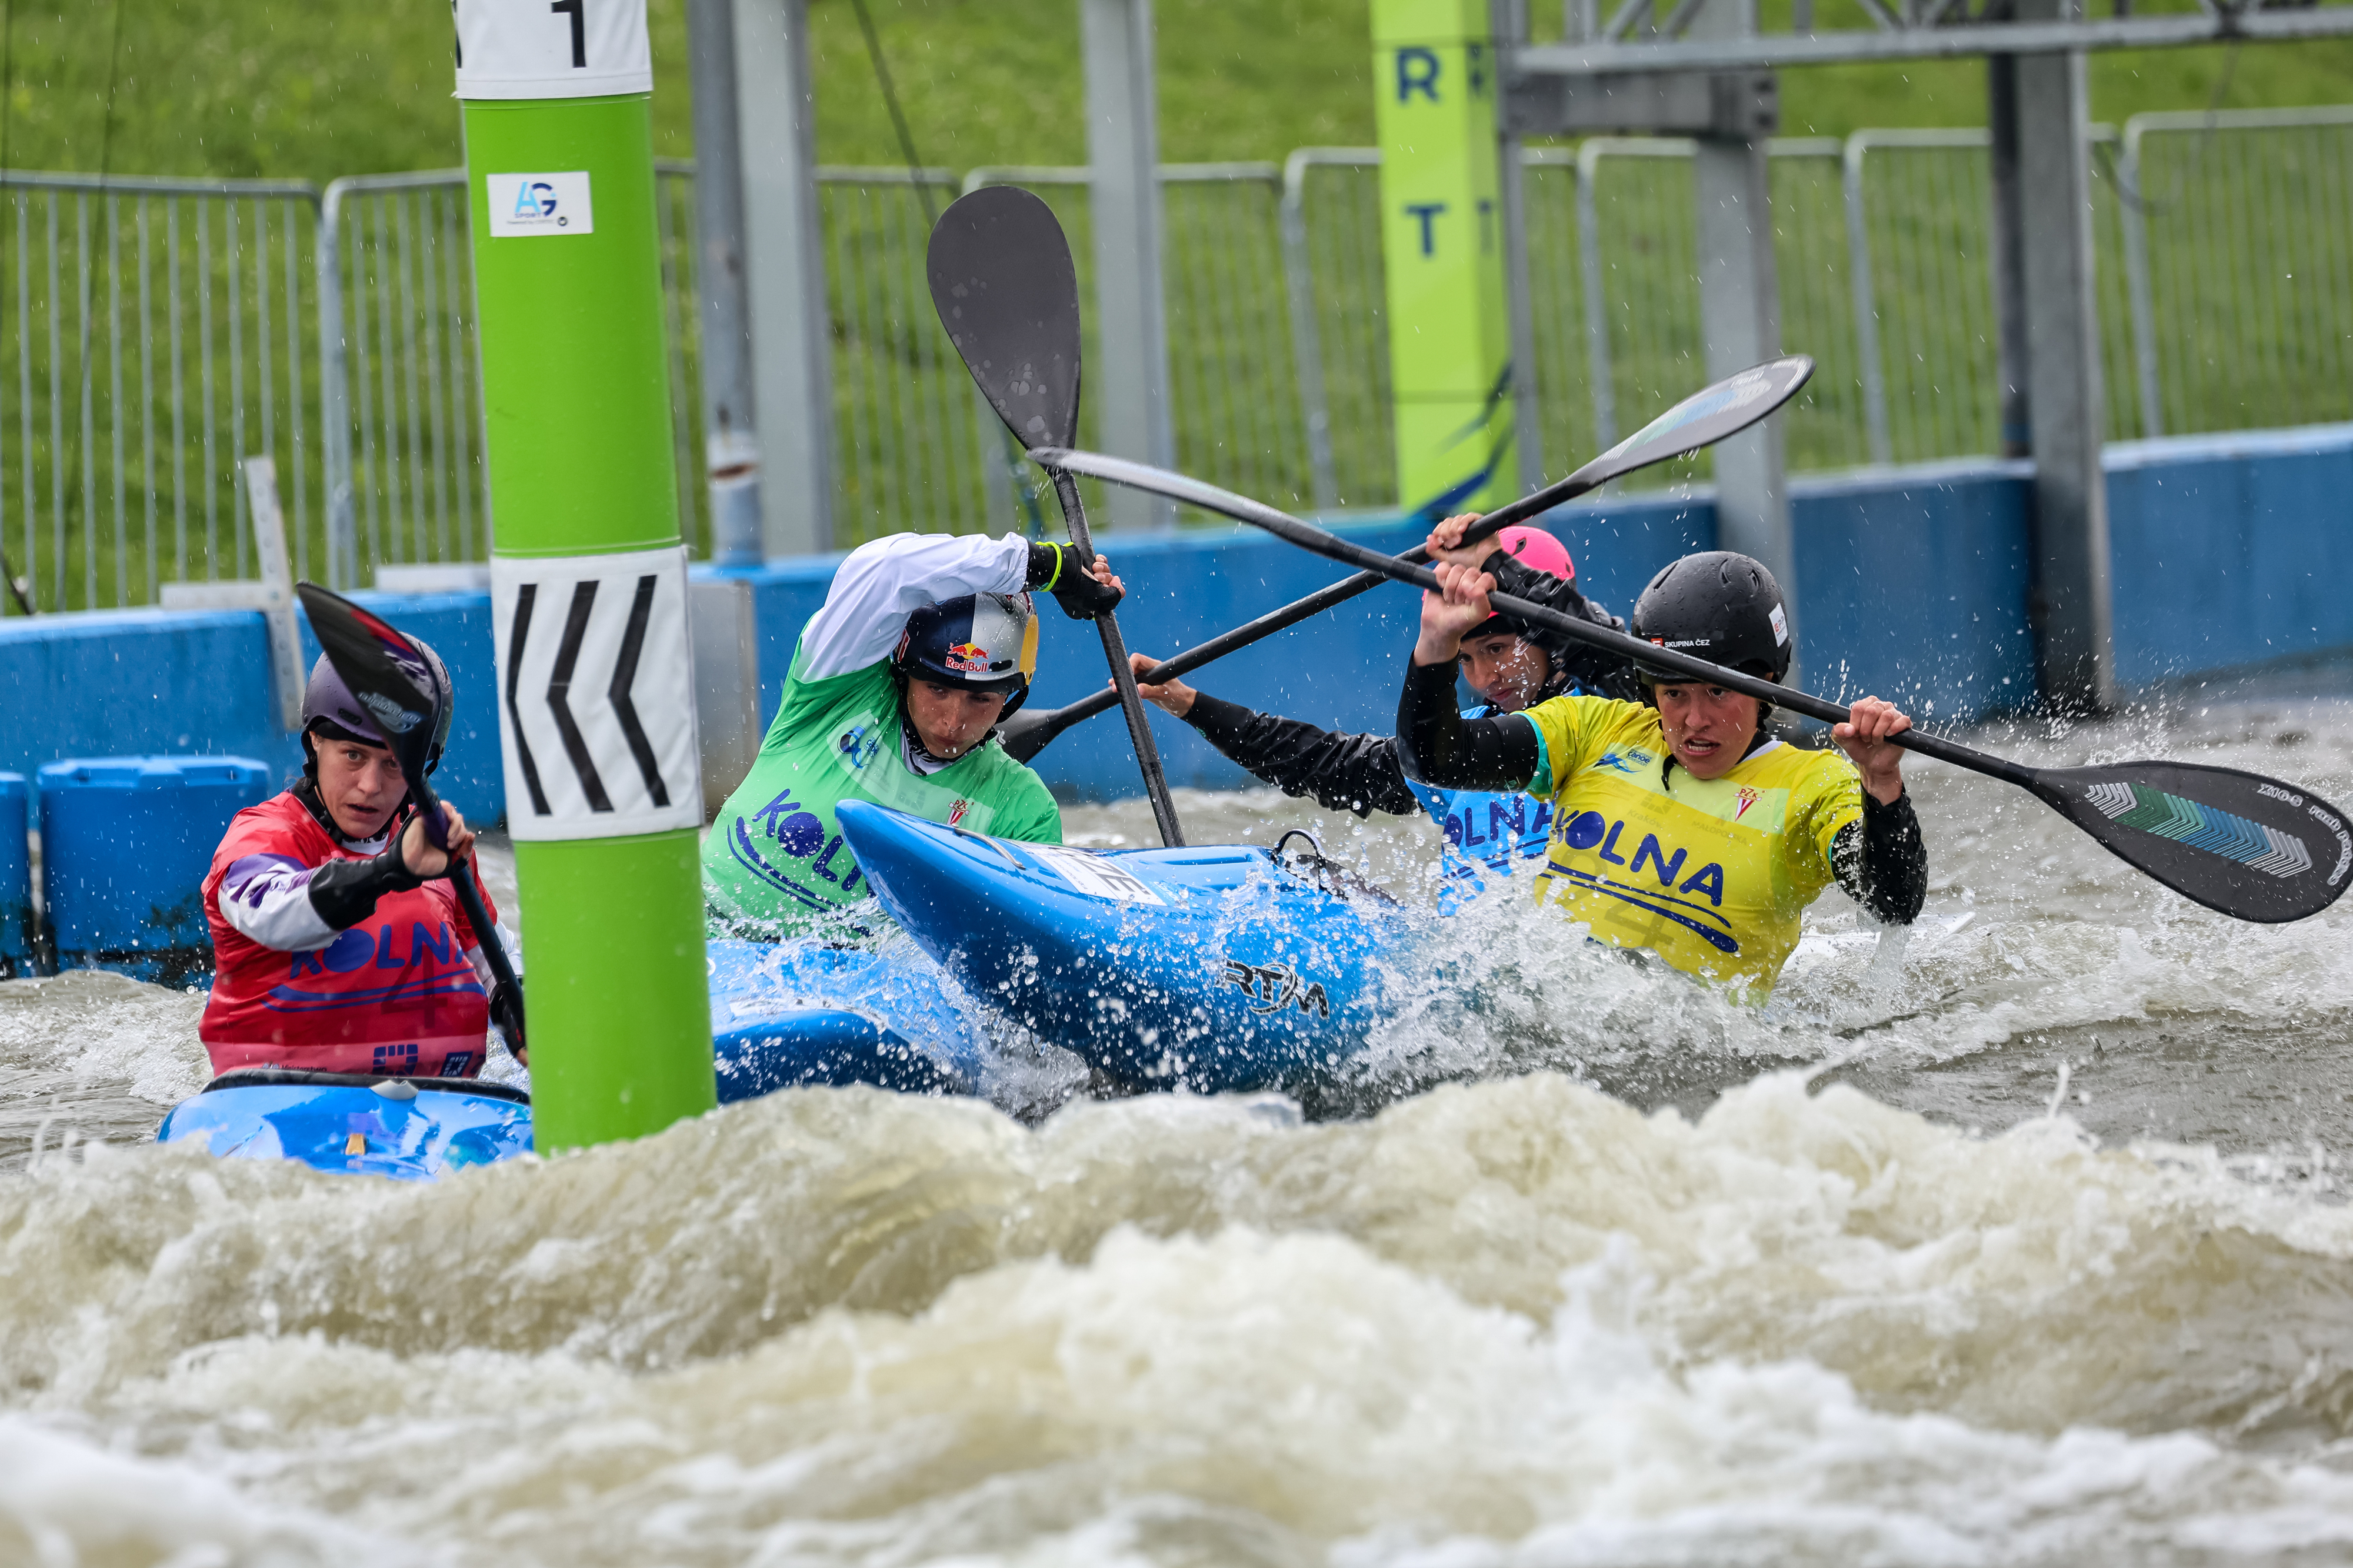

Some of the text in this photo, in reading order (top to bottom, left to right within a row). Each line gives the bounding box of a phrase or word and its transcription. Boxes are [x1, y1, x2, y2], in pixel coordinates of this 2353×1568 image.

[551, 0, 586, 68] 1
[945, 656, 988, 672] Red Bull
[1627, 751, 1651, 764] canoe
[1550, 808, 1724, 907] KOLNA
